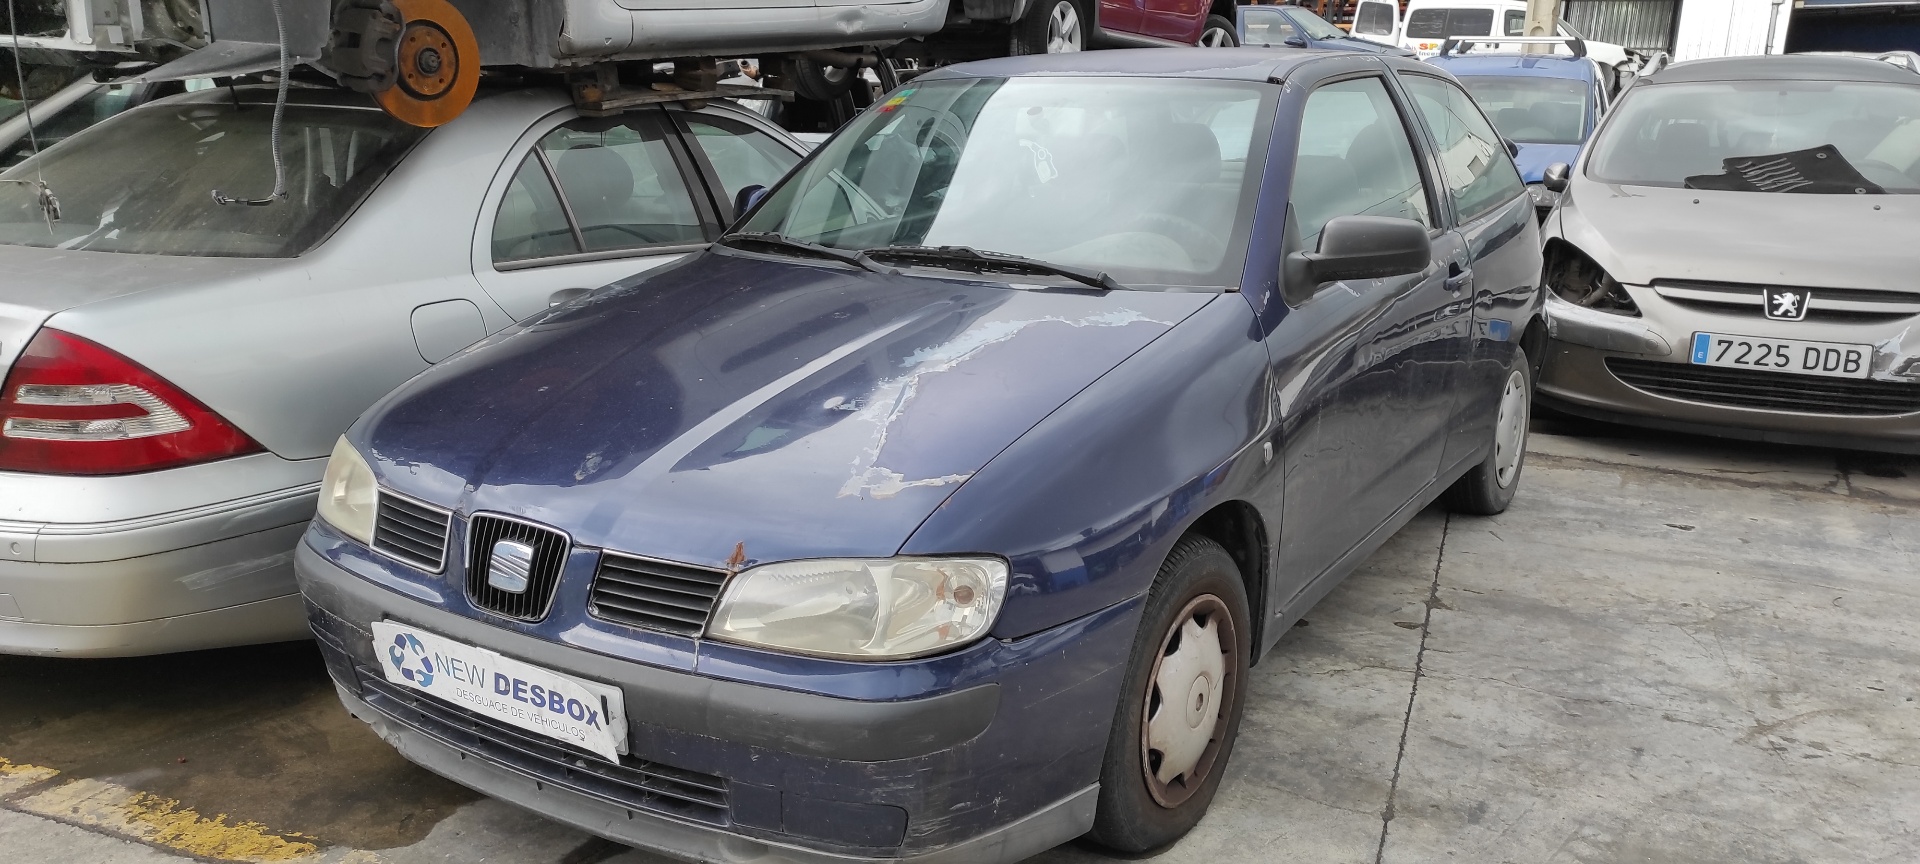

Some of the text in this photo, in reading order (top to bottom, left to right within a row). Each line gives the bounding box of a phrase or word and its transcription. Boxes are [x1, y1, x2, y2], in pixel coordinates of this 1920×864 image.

[1697, 351, 1704, 359] E
[1715, 339, 1862, 374] 7225 DDB
[434, 652, 602, 731] NEW DESBOX
[456, 687, 509, 714] DESGUACE
[510, 705, 525, 720] DE
